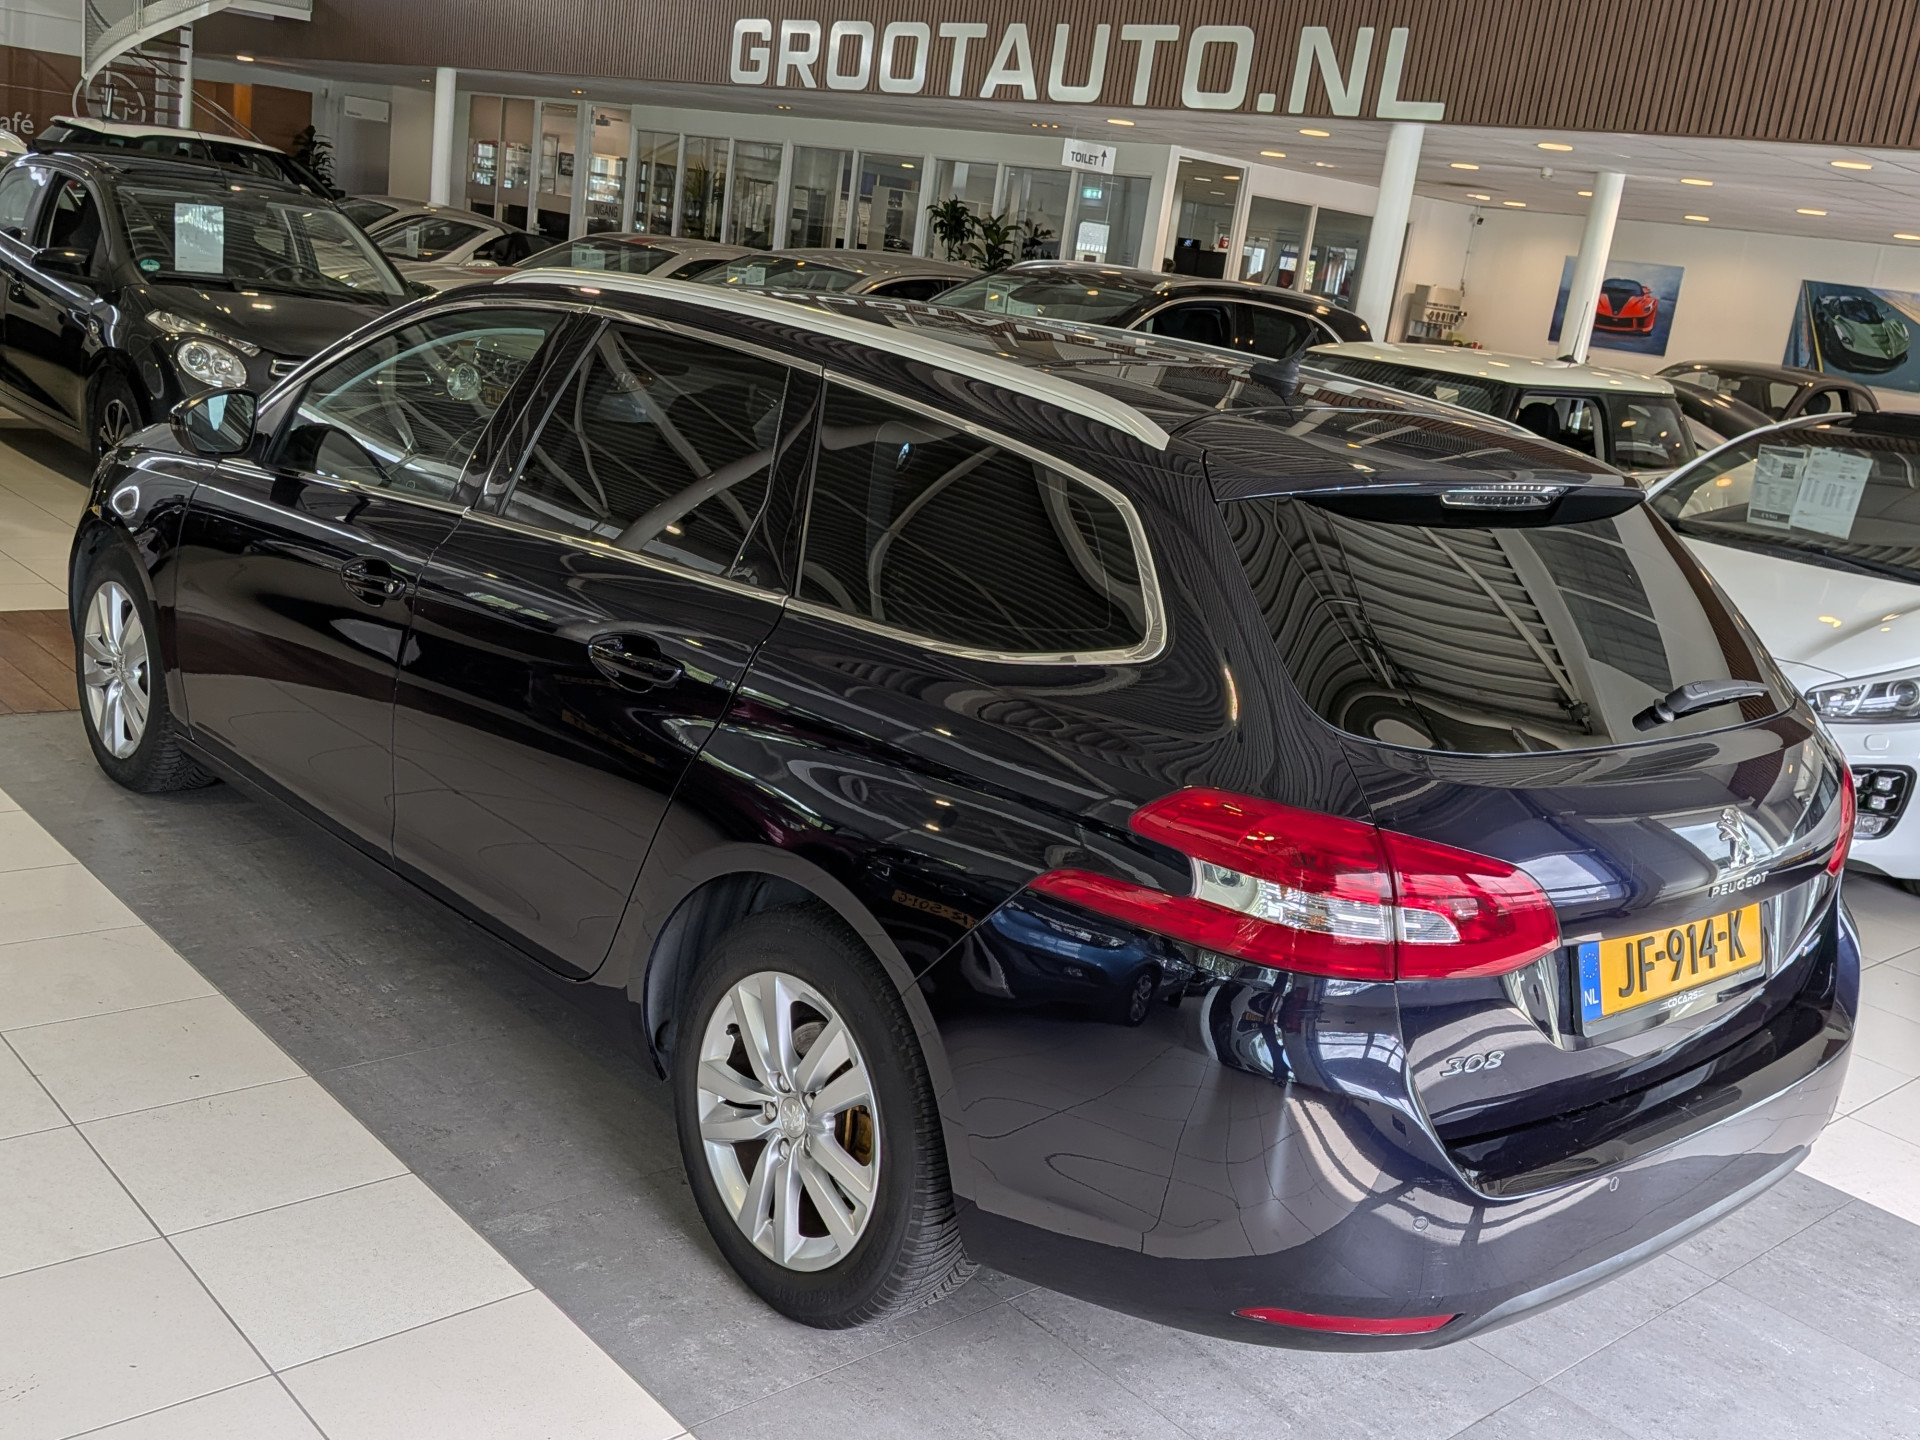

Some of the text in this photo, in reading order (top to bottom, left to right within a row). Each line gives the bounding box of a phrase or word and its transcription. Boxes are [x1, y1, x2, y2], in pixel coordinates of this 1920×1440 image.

[729, 18, 1446, 121] GROOTAUTO.NL
[1070, 151, 1099, 166] TOILET
[594, 203, 618, 218] INGANG
[1708, 872, 1769, 898] PEUGEOT
[1618, 910, 1746, 998] JF-914-K
[1584, 988, 1600, 1007] NL
[1440, 1050, 1505, 1077] 308
